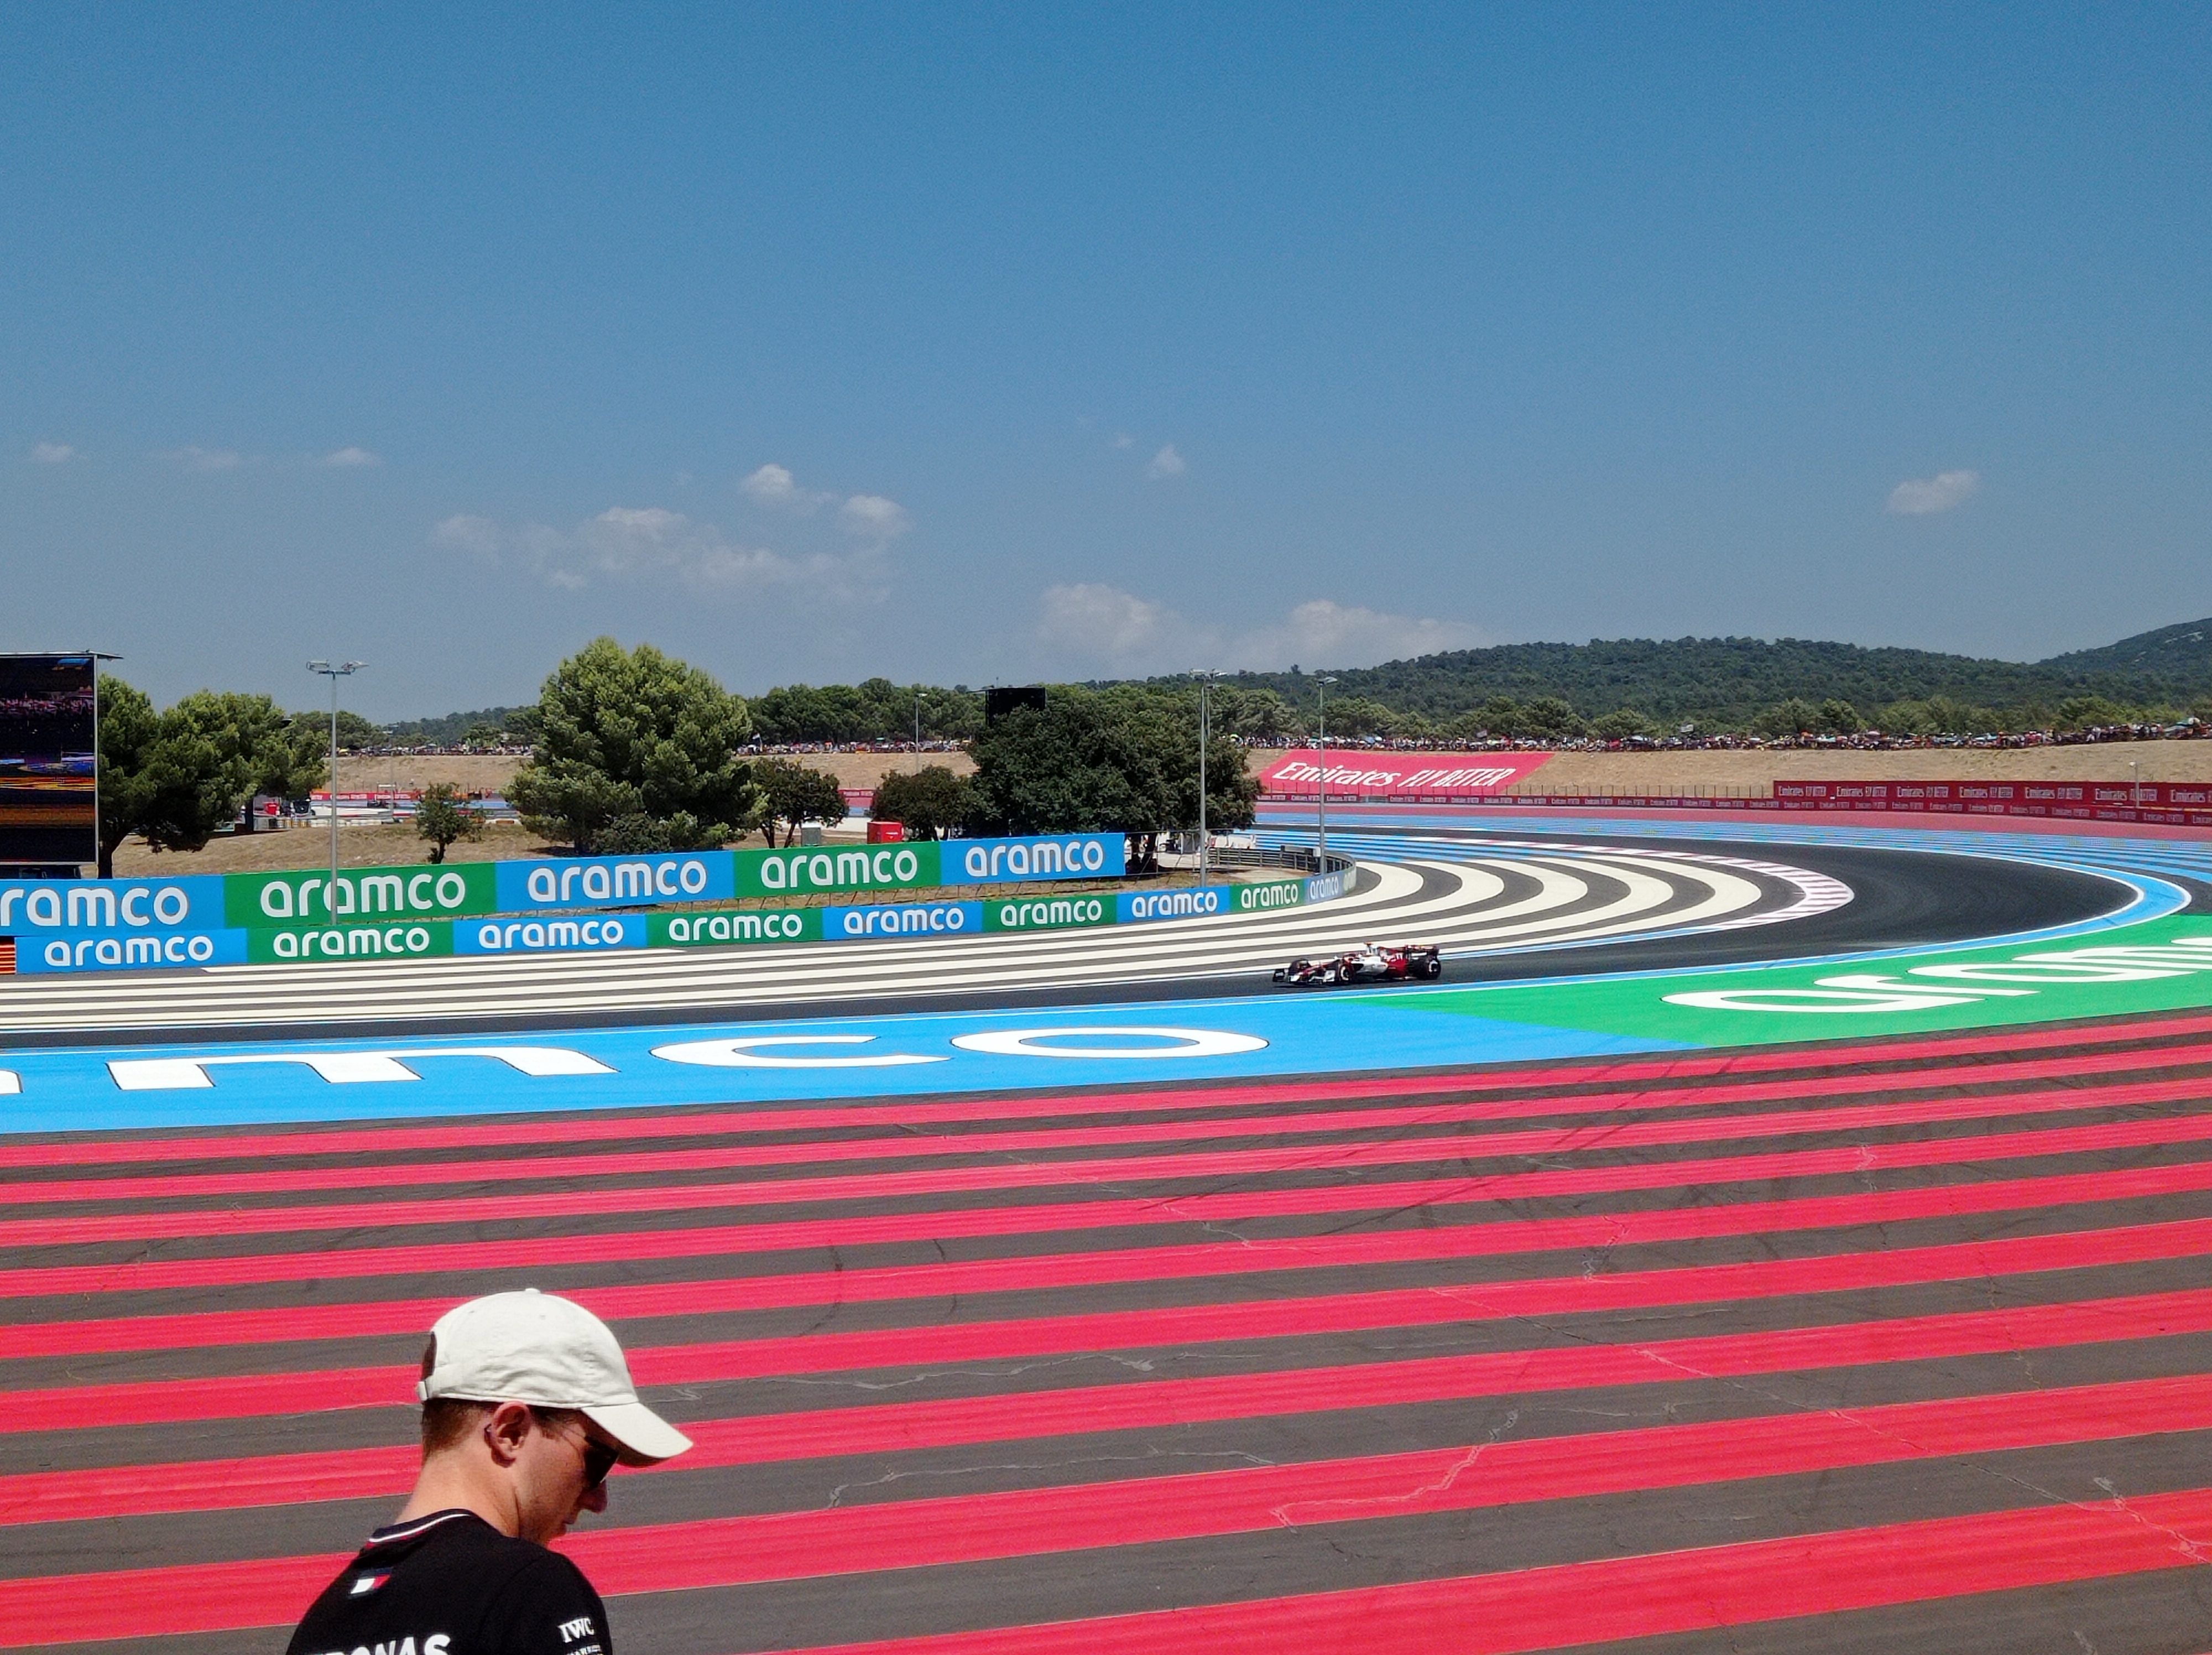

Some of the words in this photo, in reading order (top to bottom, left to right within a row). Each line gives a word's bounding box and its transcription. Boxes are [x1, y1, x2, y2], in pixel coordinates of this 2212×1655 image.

[1272, 761, 1402, 787] Emirates
[1430, 768, 1516, 787] BETTER
[760, 850, 917, 888] aramco
[965, 841, 1104, 877] aramco
[260, 872, 466, 918] aramco
[527, 861, 707, 902] aramco
[1240, 883, 1299, 908] aramco
[1310, 876, 1339, 900] aramco
[0, 887, 189, 927] ramco
[1000, 900, 1102, 927] aramco
[1133, 891, 1218, 918] aramco
[478, 920, 624, 949] aramco
[669, 914, 802, 941] aramco
[844, 908, 964, 934] aramco
[45, 936, 213, 966] aramco
[273, 927, 430, 957] aramco
[1660, 937, 2212, 1013] aram
[0, 1027, 1269, 1096] mco
[557, 1617, 595, 1643] IWC
